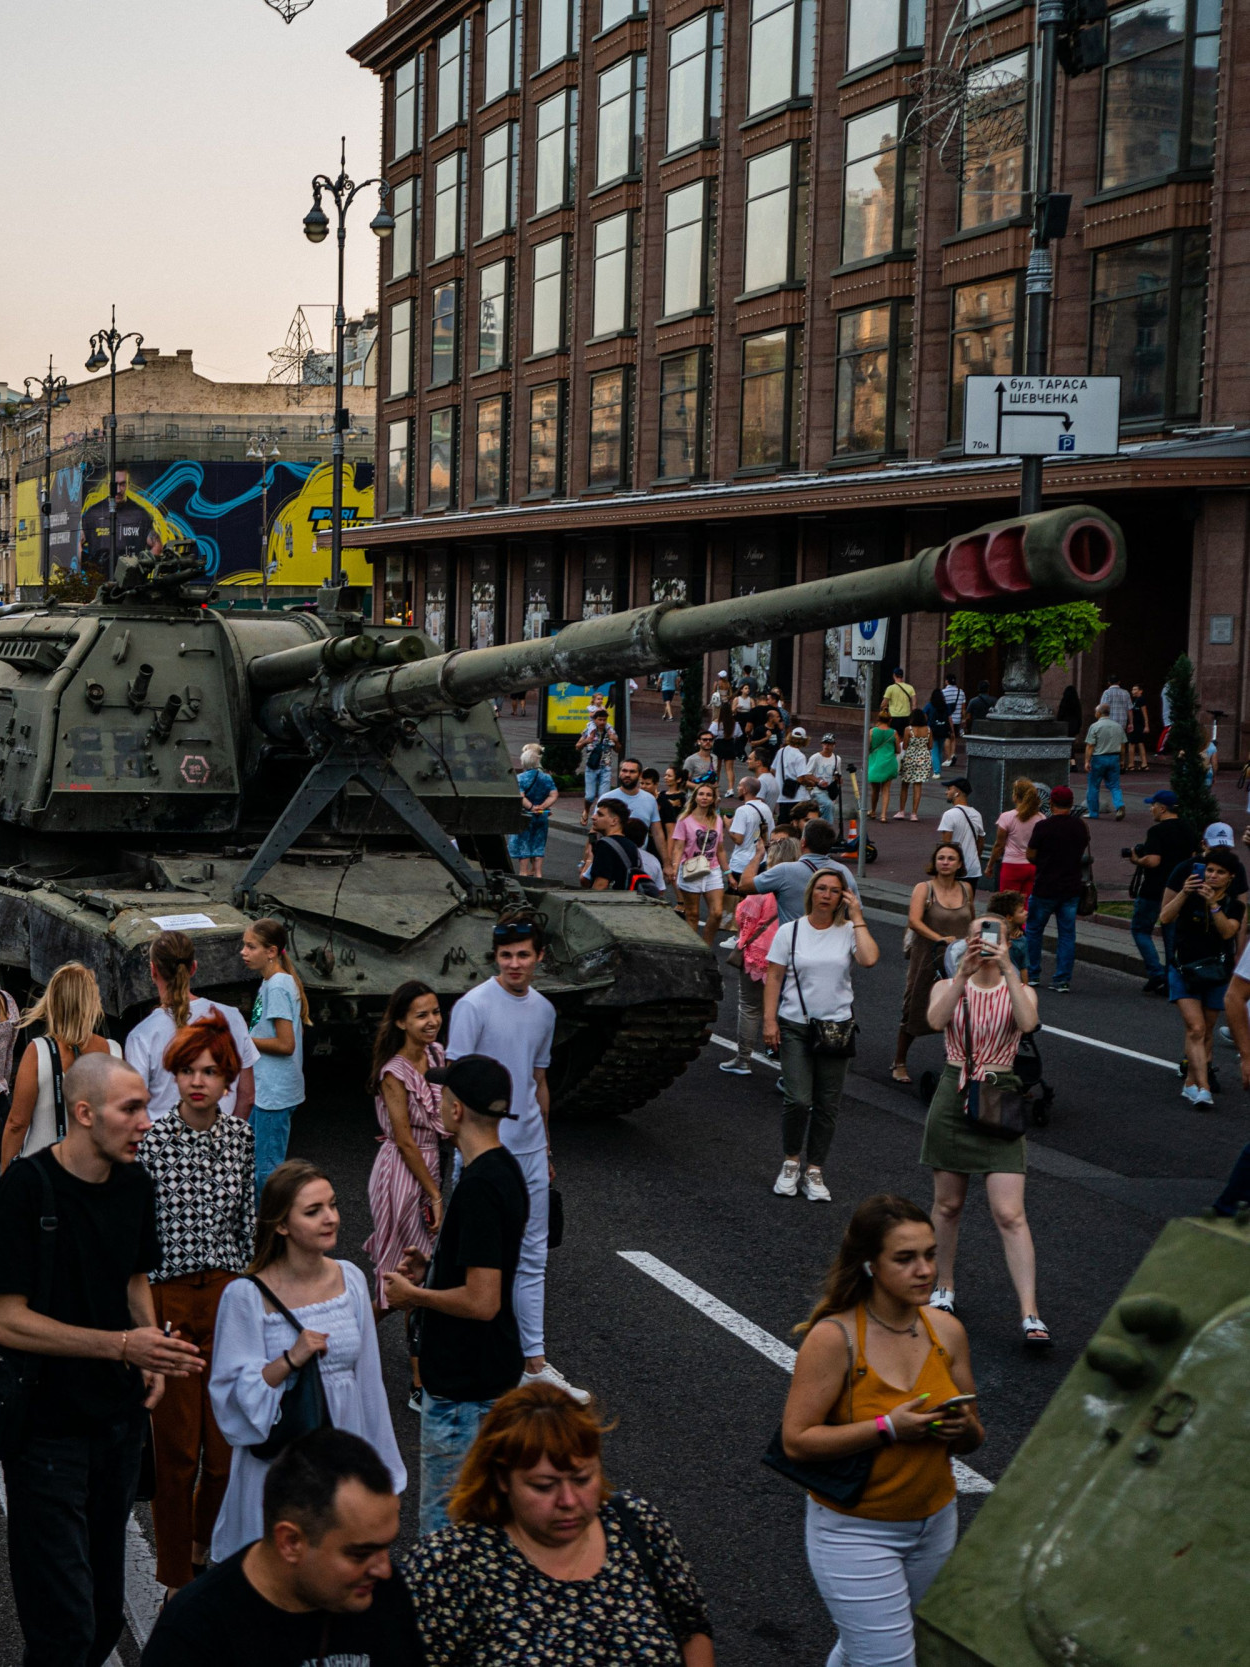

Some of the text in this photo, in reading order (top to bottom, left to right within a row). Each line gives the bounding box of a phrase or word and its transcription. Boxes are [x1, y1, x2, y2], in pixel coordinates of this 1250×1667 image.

[1010, 379, 1088, 391] бул. ТАРАСА
[1010, 393, 1079, 404] ШЕВЧЕНКА
[972, 441, 990, 449] 70м
[123, 527, 140, 537] USYK
[857, 645, 876, 656] ЗОНА
